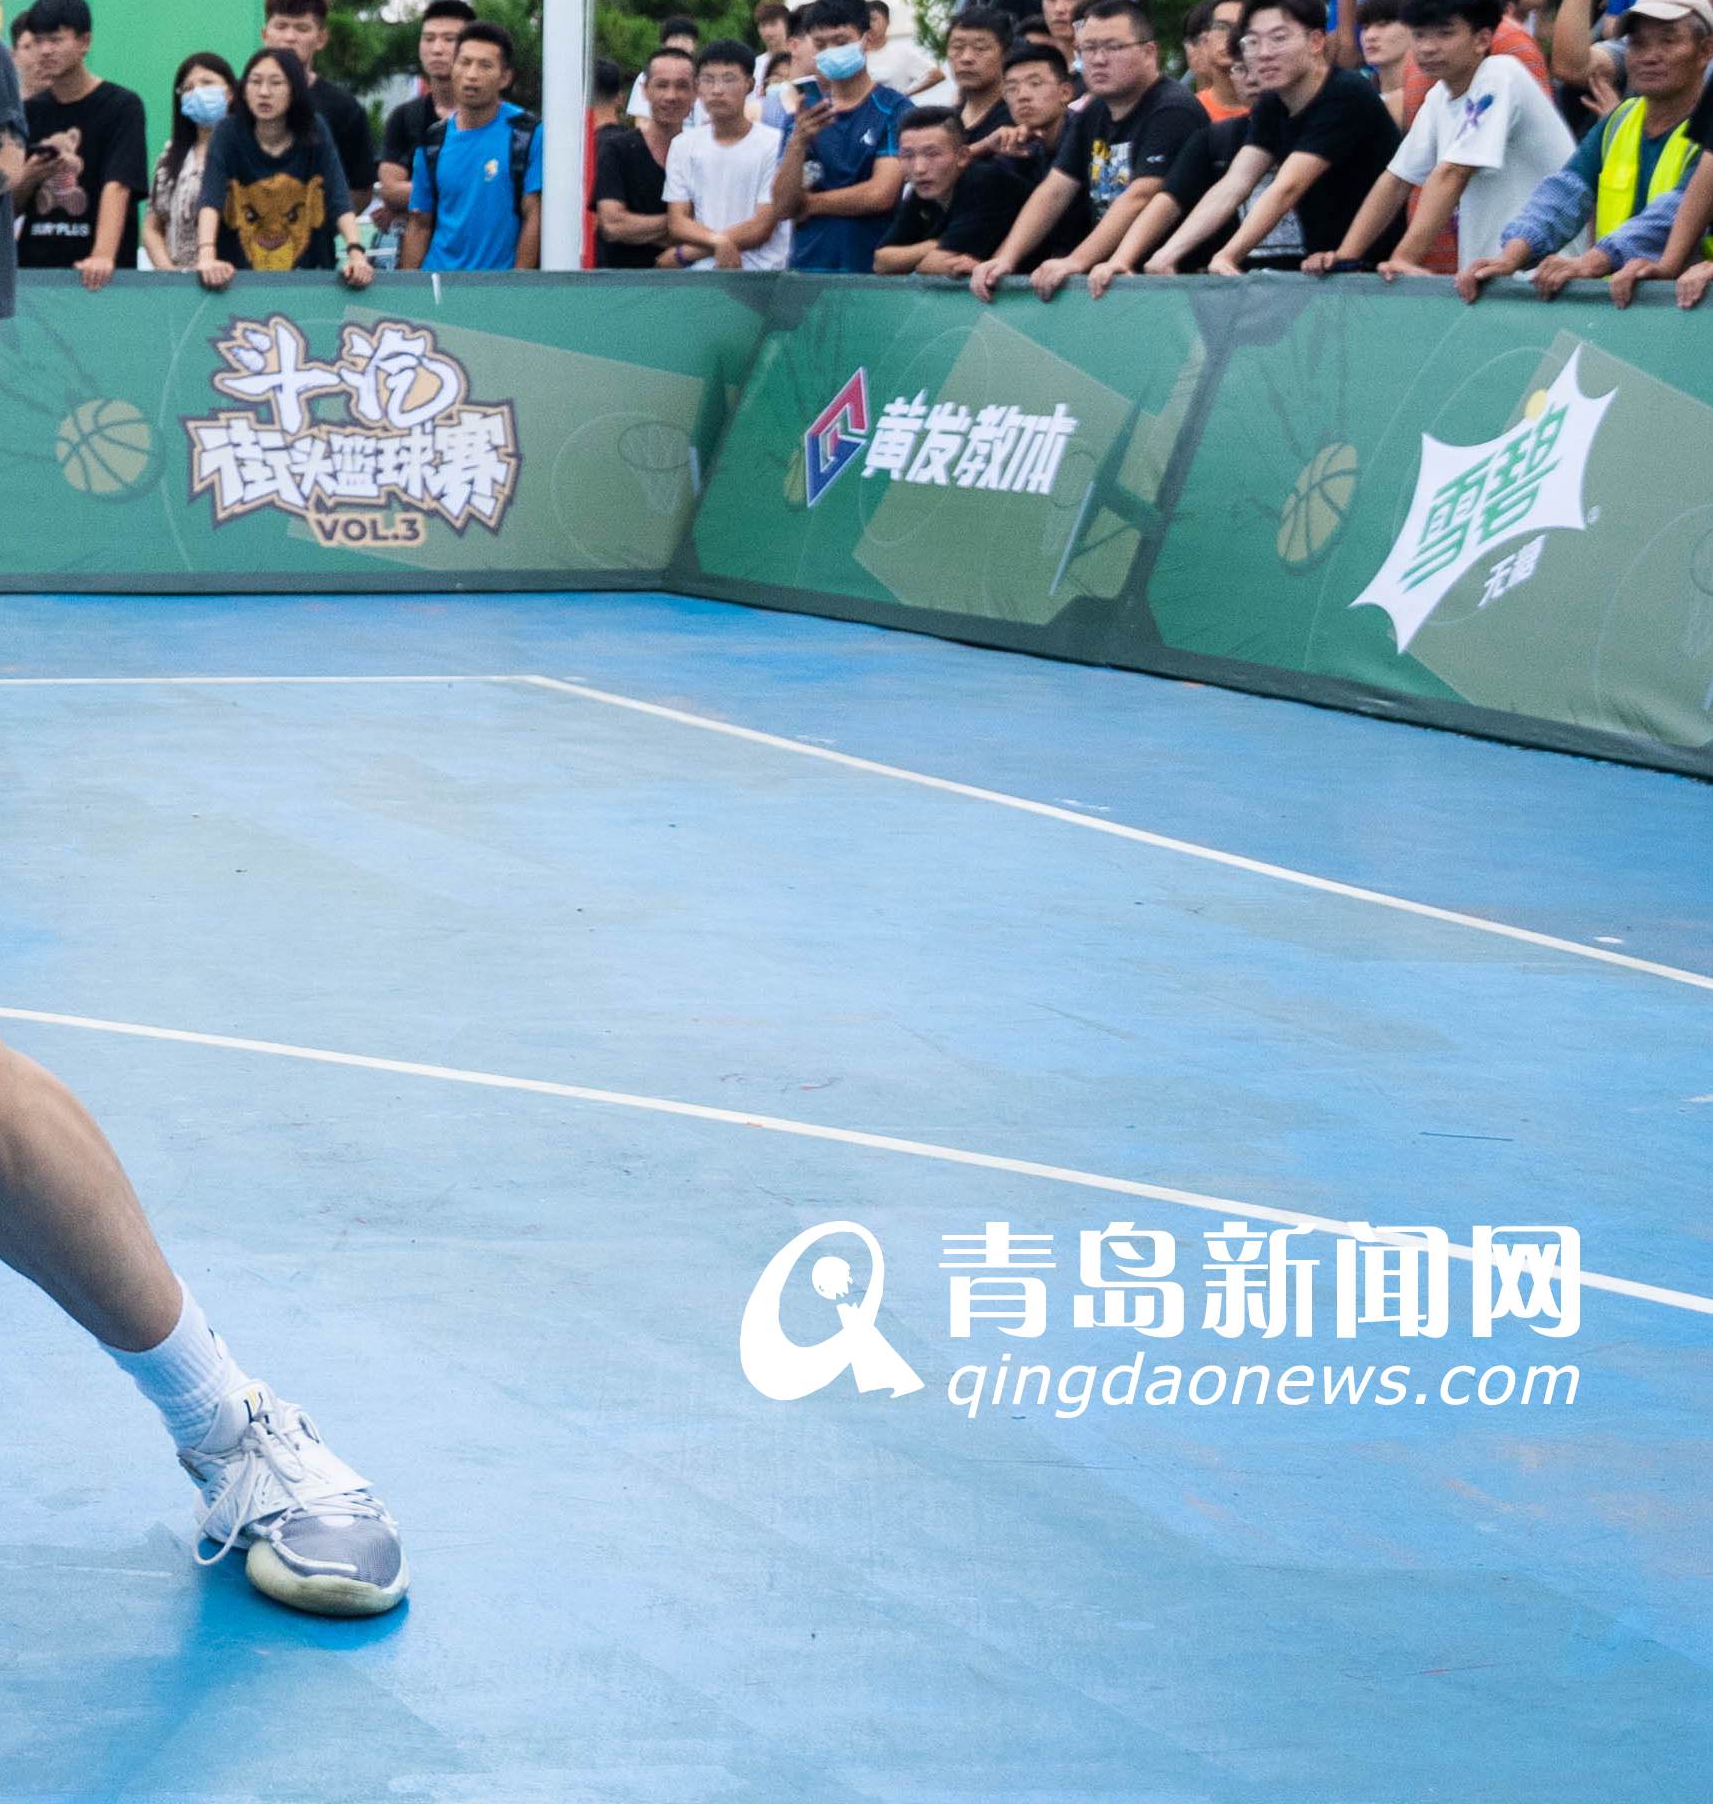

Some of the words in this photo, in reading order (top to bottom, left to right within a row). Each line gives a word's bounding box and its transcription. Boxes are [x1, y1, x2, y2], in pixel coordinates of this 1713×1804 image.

[195, 411, 510, 519] 街头篮球赛
[861, 389, 1078, 495] 黄发教体
[316, 517, 421, 541] VOL.3
[1397, 403, 1570, 593] 雪碧
